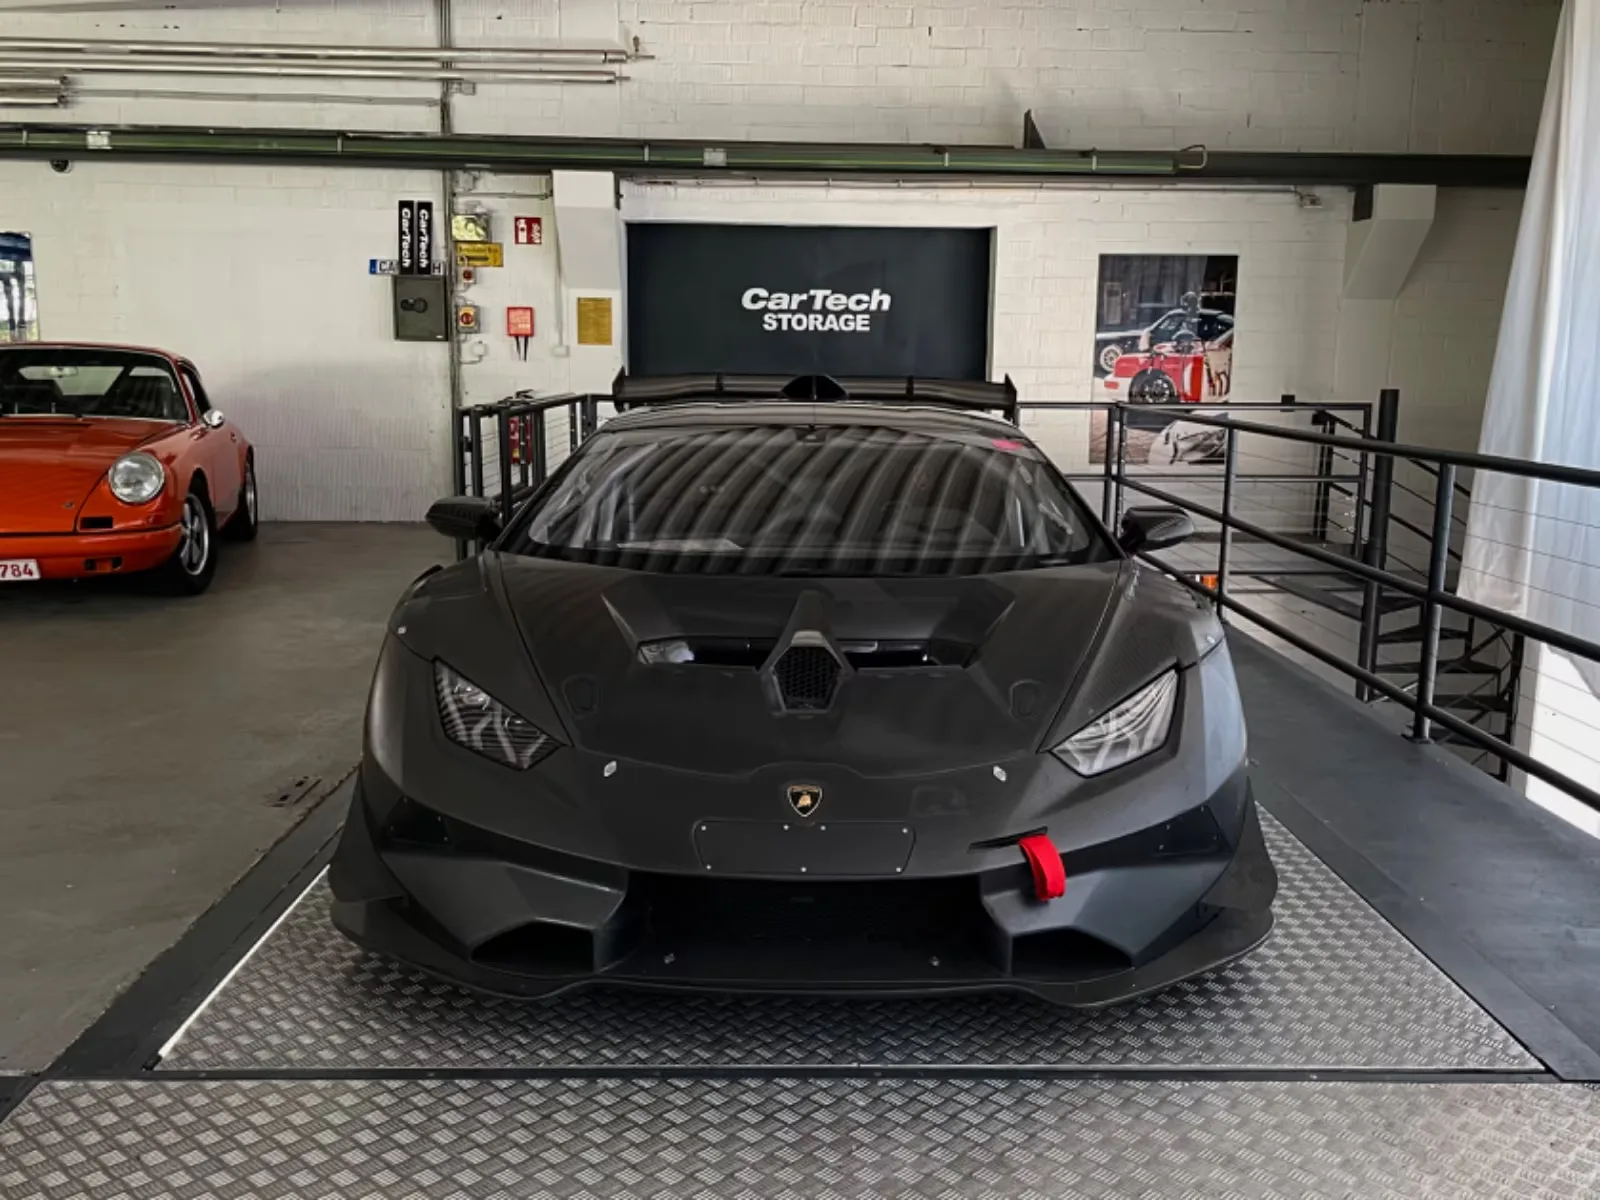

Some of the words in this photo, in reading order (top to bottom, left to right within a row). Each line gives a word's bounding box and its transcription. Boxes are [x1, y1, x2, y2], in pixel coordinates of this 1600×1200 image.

[402, 208, 411, 268] CarTech
[419, 209, 429, 268] CarTech
[741, 287, 892, 312] CarTech
[762, 312, 871, 331] STORAGE
[0, 564, 34, 578] 784
